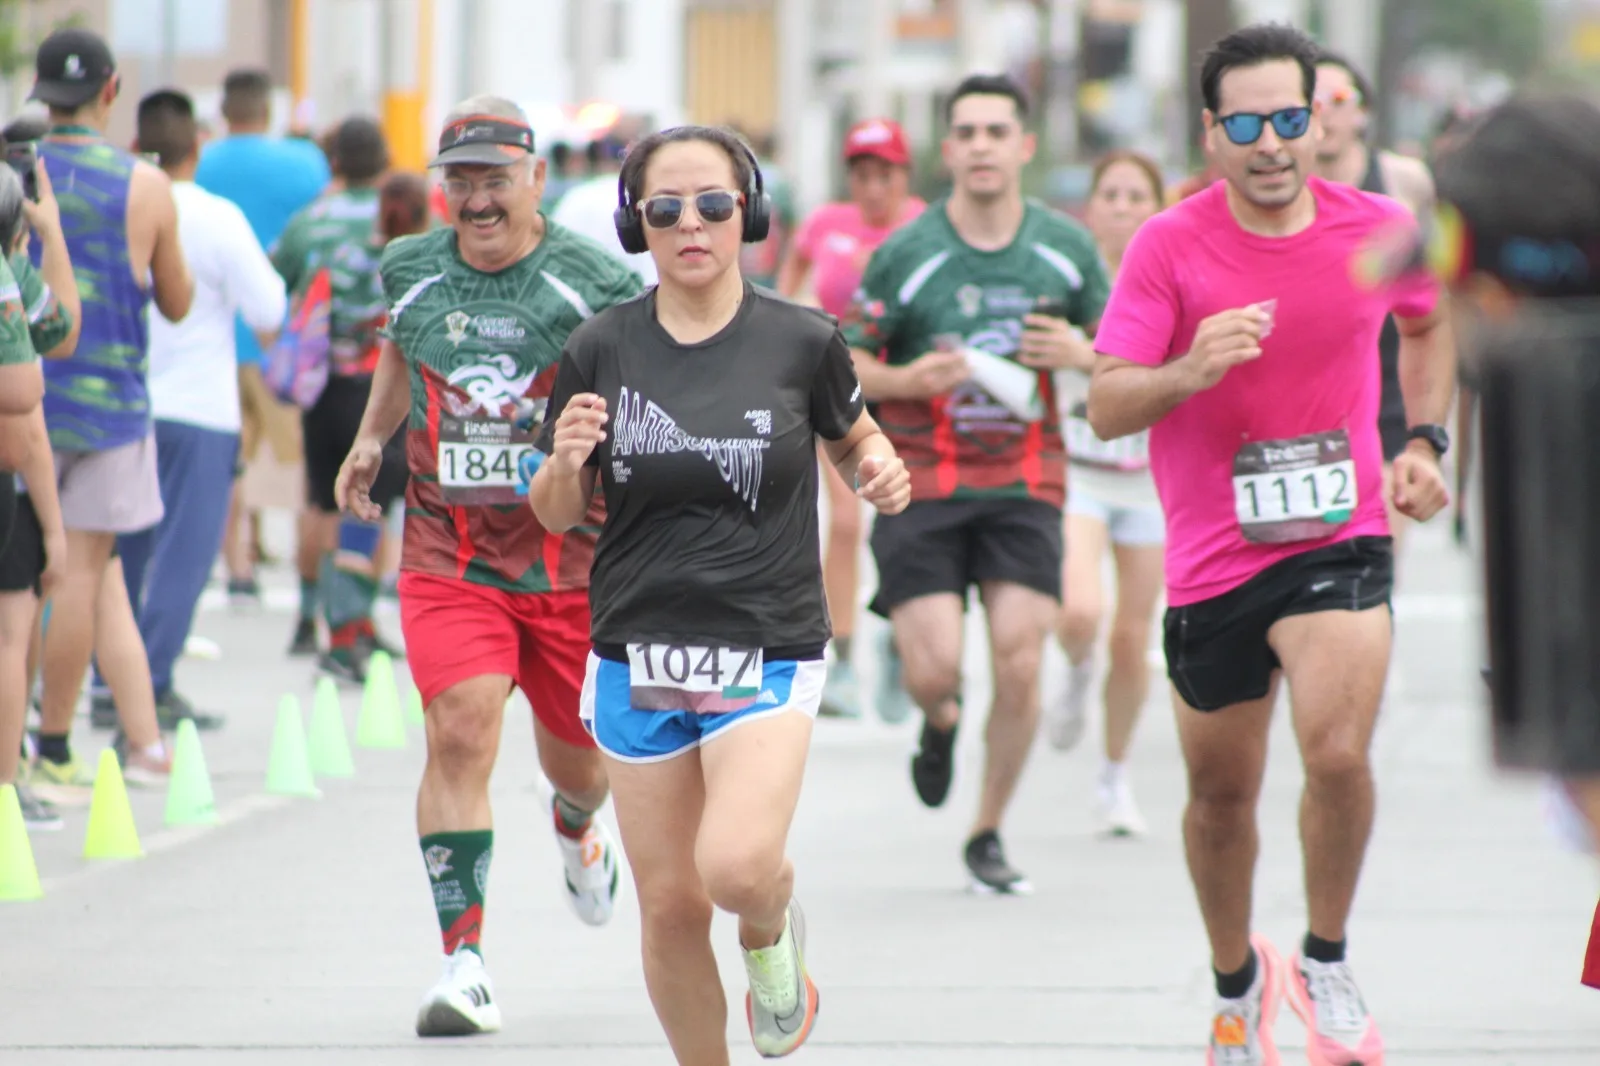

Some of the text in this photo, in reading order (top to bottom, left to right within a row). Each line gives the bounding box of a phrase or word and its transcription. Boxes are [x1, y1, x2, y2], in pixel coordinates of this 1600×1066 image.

[444, 447, 534, 481] 184
[1243, 466, 1350, 517] 1112
[635, 643, 758, 687] 1047
